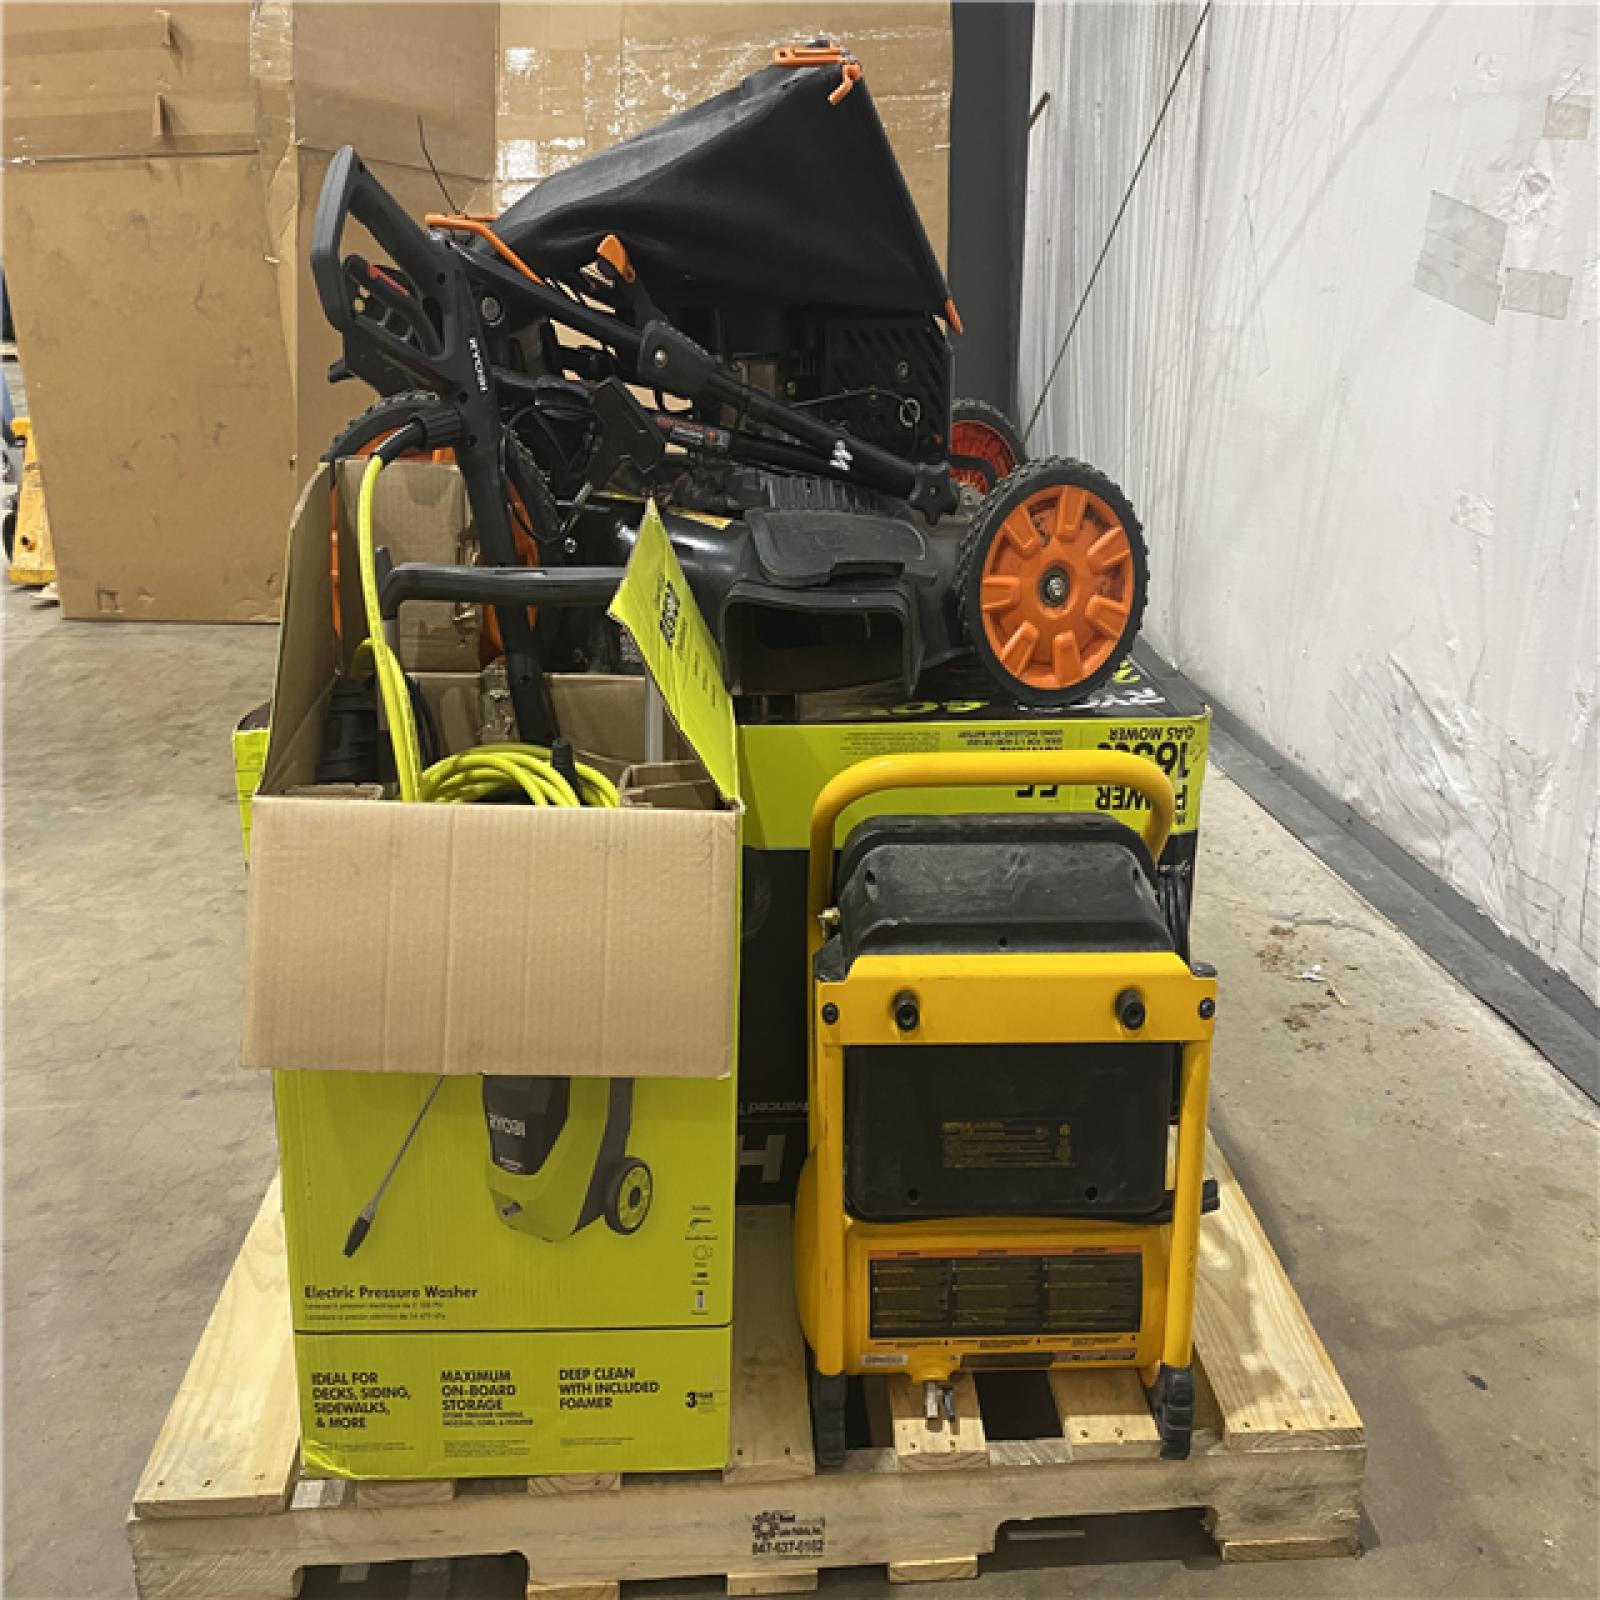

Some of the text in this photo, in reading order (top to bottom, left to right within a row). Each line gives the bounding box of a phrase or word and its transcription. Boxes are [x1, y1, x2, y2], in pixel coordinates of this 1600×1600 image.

[1109, 725, 1196, 741] GAS MOWER
[1094, 783, 1189, 811] PWER
[304, 1284, 479, 1300] Electric Pressure Washer
[311, 1371, 378, 1385] IDEAL FOR
[440, 1369, 512, 1382] MAXIMUM
[559, 1367, 636, 1381] DEEP CLEAN
[312, 1386, 412, 1400] DECKS, SIDING,
[441, 1384, 518, 1396] ON-BOARD
[559, 1381, 660, 1395] WITH INCLUDED
[442, 1399, 504, 1411] STORAGE
[559, 1397, 613, 1410] FOAMER
[685, 1391, 697, 1408] 3
[314, 1401, 391, 1415] SIDEWALKS,
[315, 1416, 367, 1429] & MORE
